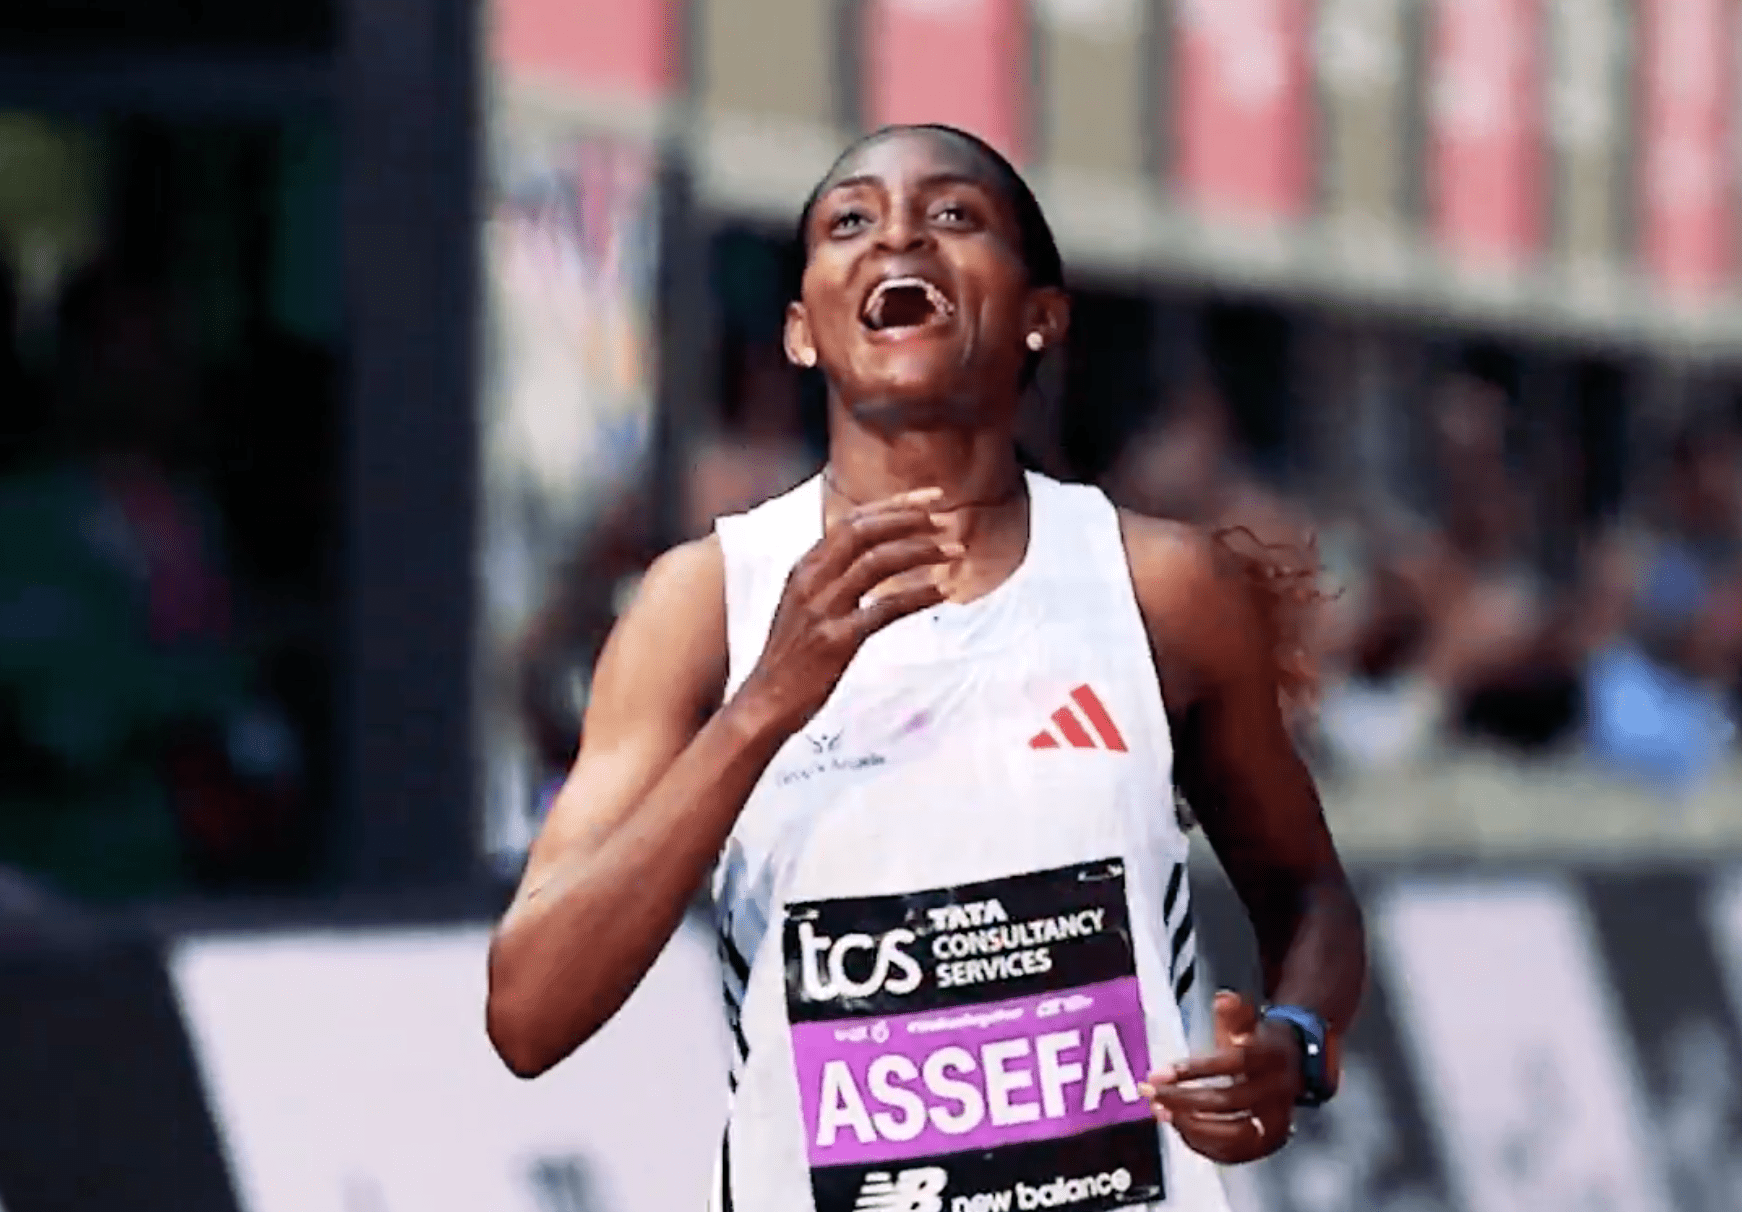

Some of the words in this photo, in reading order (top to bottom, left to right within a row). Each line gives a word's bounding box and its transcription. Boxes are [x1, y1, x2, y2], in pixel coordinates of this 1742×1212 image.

[926, 898, 1008, 932] TATA
[931, 906, 1106, 960] CONSULTANCY
[798, 920, 923, 1002] tcs
[936, 949, 1053, 989] SERVICES
[815, 1022, 1140, 1148] ASSEFA
[951, 1187, 1013, 1212] new
[1016, 1167, 1132, 1211] balance
